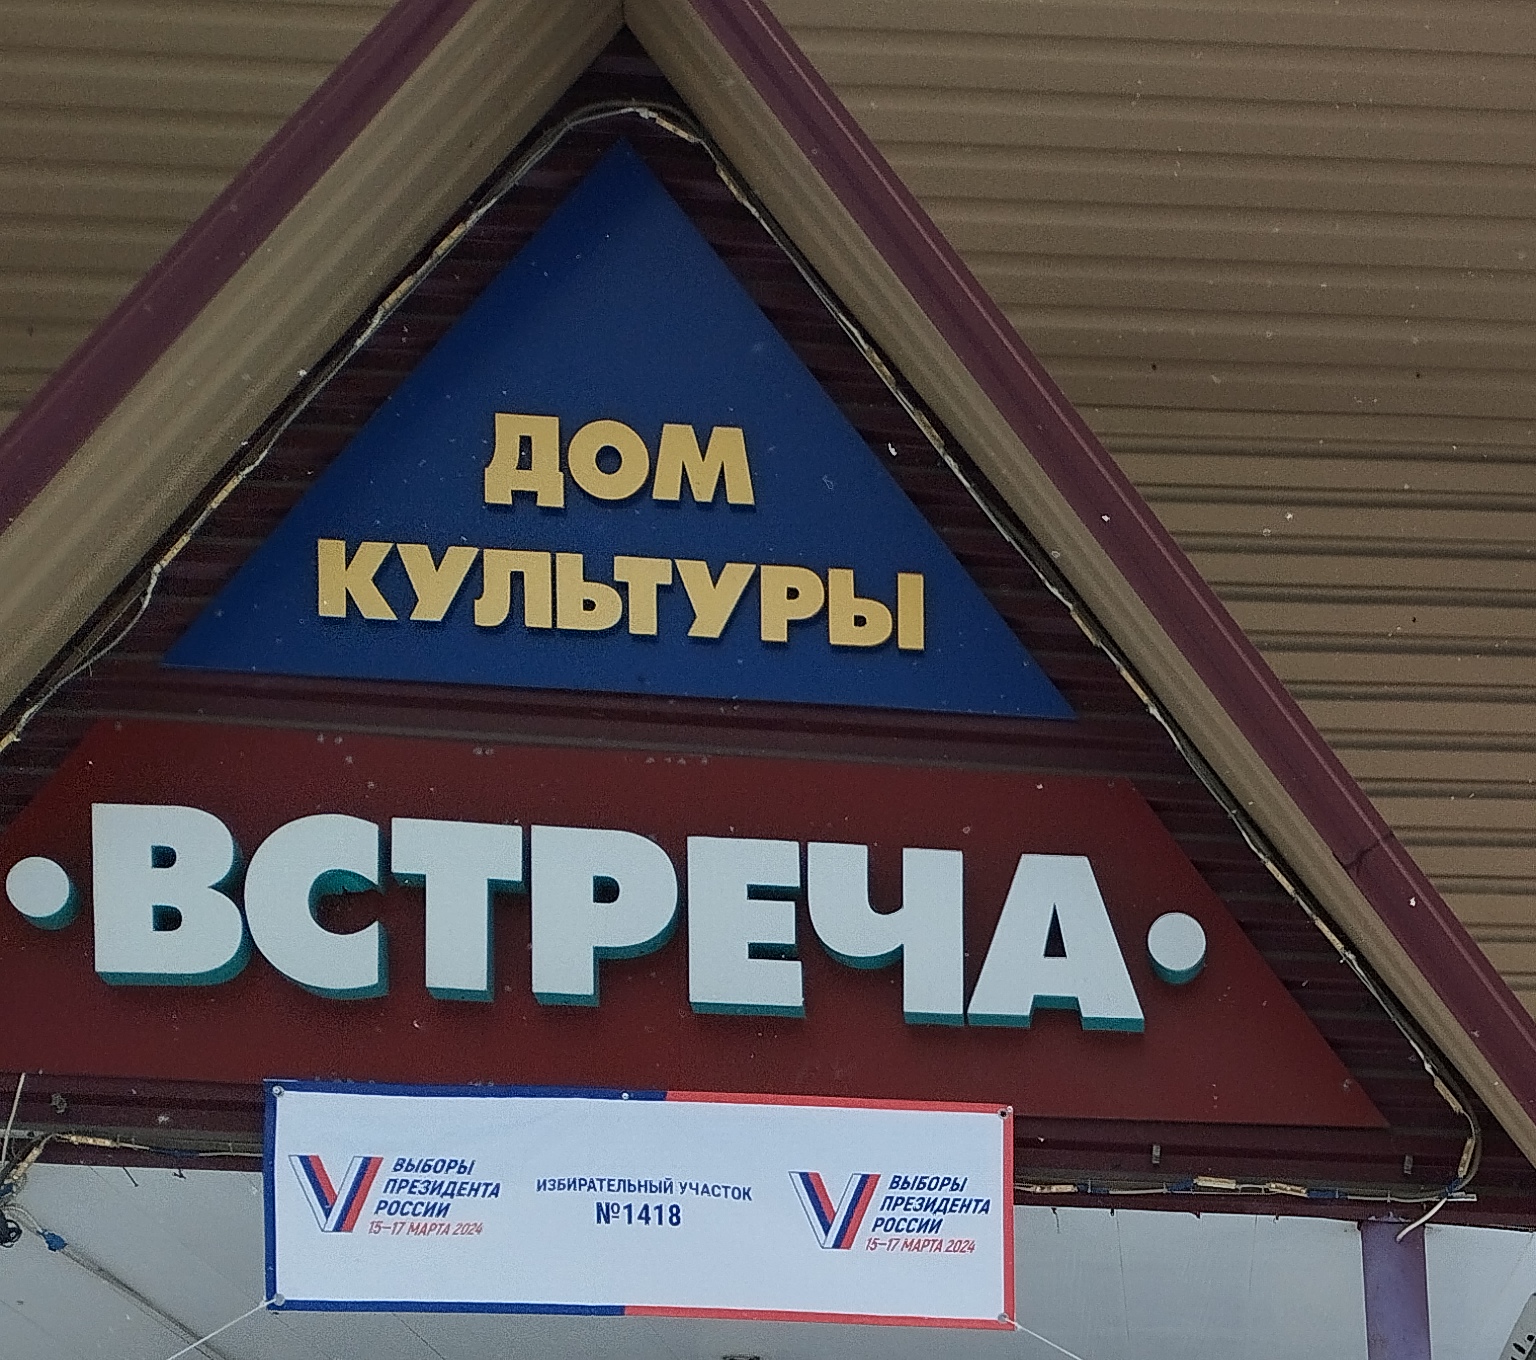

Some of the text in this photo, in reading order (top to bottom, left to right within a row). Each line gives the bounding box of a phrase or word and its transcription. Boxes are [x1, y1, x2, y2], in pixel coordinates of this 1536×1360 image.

[483, 413, 757, 508] ДОМ
[317, 538, 926, 653] КУЛЬТУРЫ
[91, 803, 1146, 1031] ВСТРЕЧА
[392, 1158, 475, 1175] ВЫБОРЫ
[383, 1178, 500, 1198] ПРЕЗИДЕНТА
[537, 1178, 752, 1201] ИЗБИРАТЕЛЬНЫЙ УЧАСТОК
[889, 1175, 967, 1192] ВЫБОРЫ
[374, 1200, 451, 1218] РОССИИ
[596, 1202, 681, 1226] №1418
[880, 1196, 990, 1214] ПРЕЗИДЕНТА
[407, 1223, 449, 1235] МАРТА
[453, 1223, 483, 1235] 2024
[872, 1217, 943, 1234] РОССИИ
[901, 1239, 942, 1252] МАРТА
[945, 1240, 975, 1253] 2024
